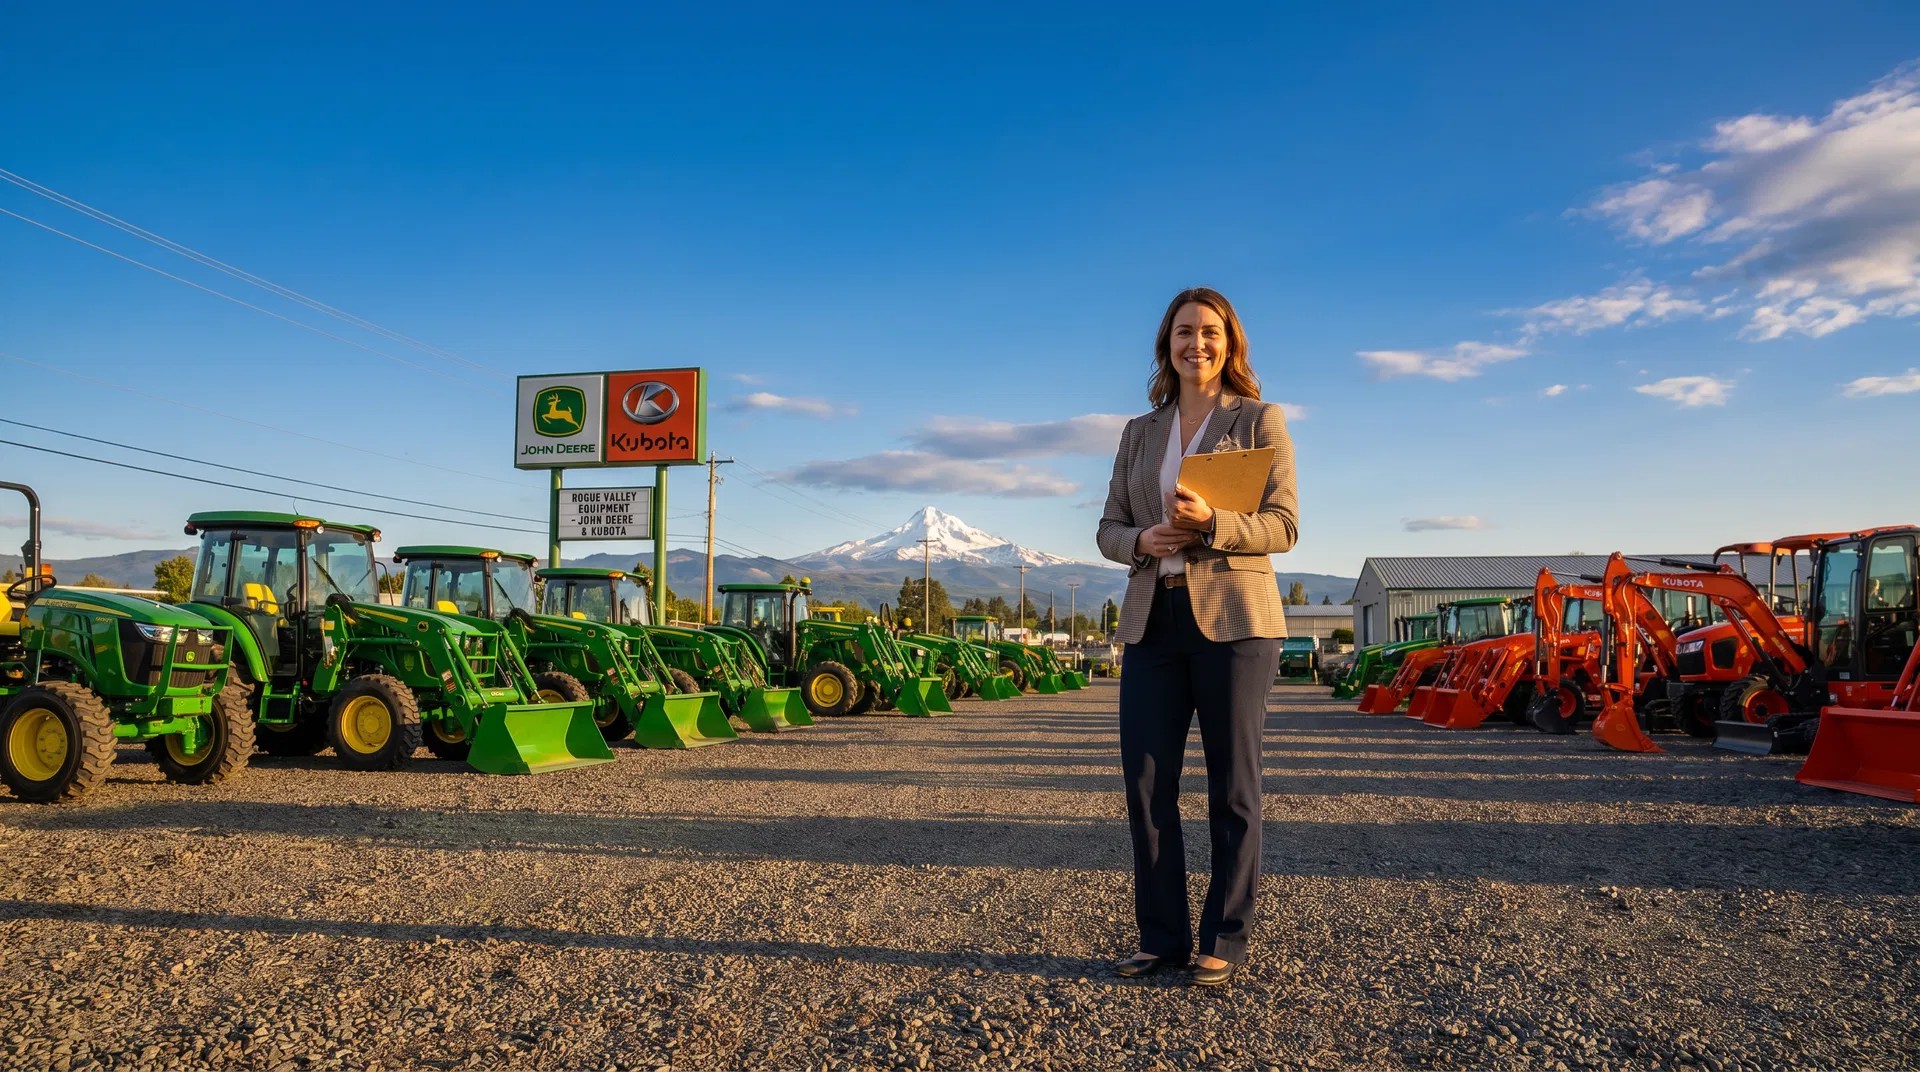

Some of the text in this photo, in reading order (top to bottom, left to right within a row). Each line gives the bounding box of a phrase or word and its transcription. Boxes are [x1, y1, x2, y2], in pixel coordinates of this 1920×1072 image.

[611, 432, 689, 452] Kubota
[521, 443, 596, 455] JOHN DEERE
[572, 492, 637, 502] ROGUE VALLEY
[578, 503, 630, 513] EQUIPMENT
[578, 515, 602, 525] JOHN
[605, 515, 633, 524] DEERE
[581, 526, 627, 536] & KUBOTA
[1662, 577, 1704, 588] KUBOTA
